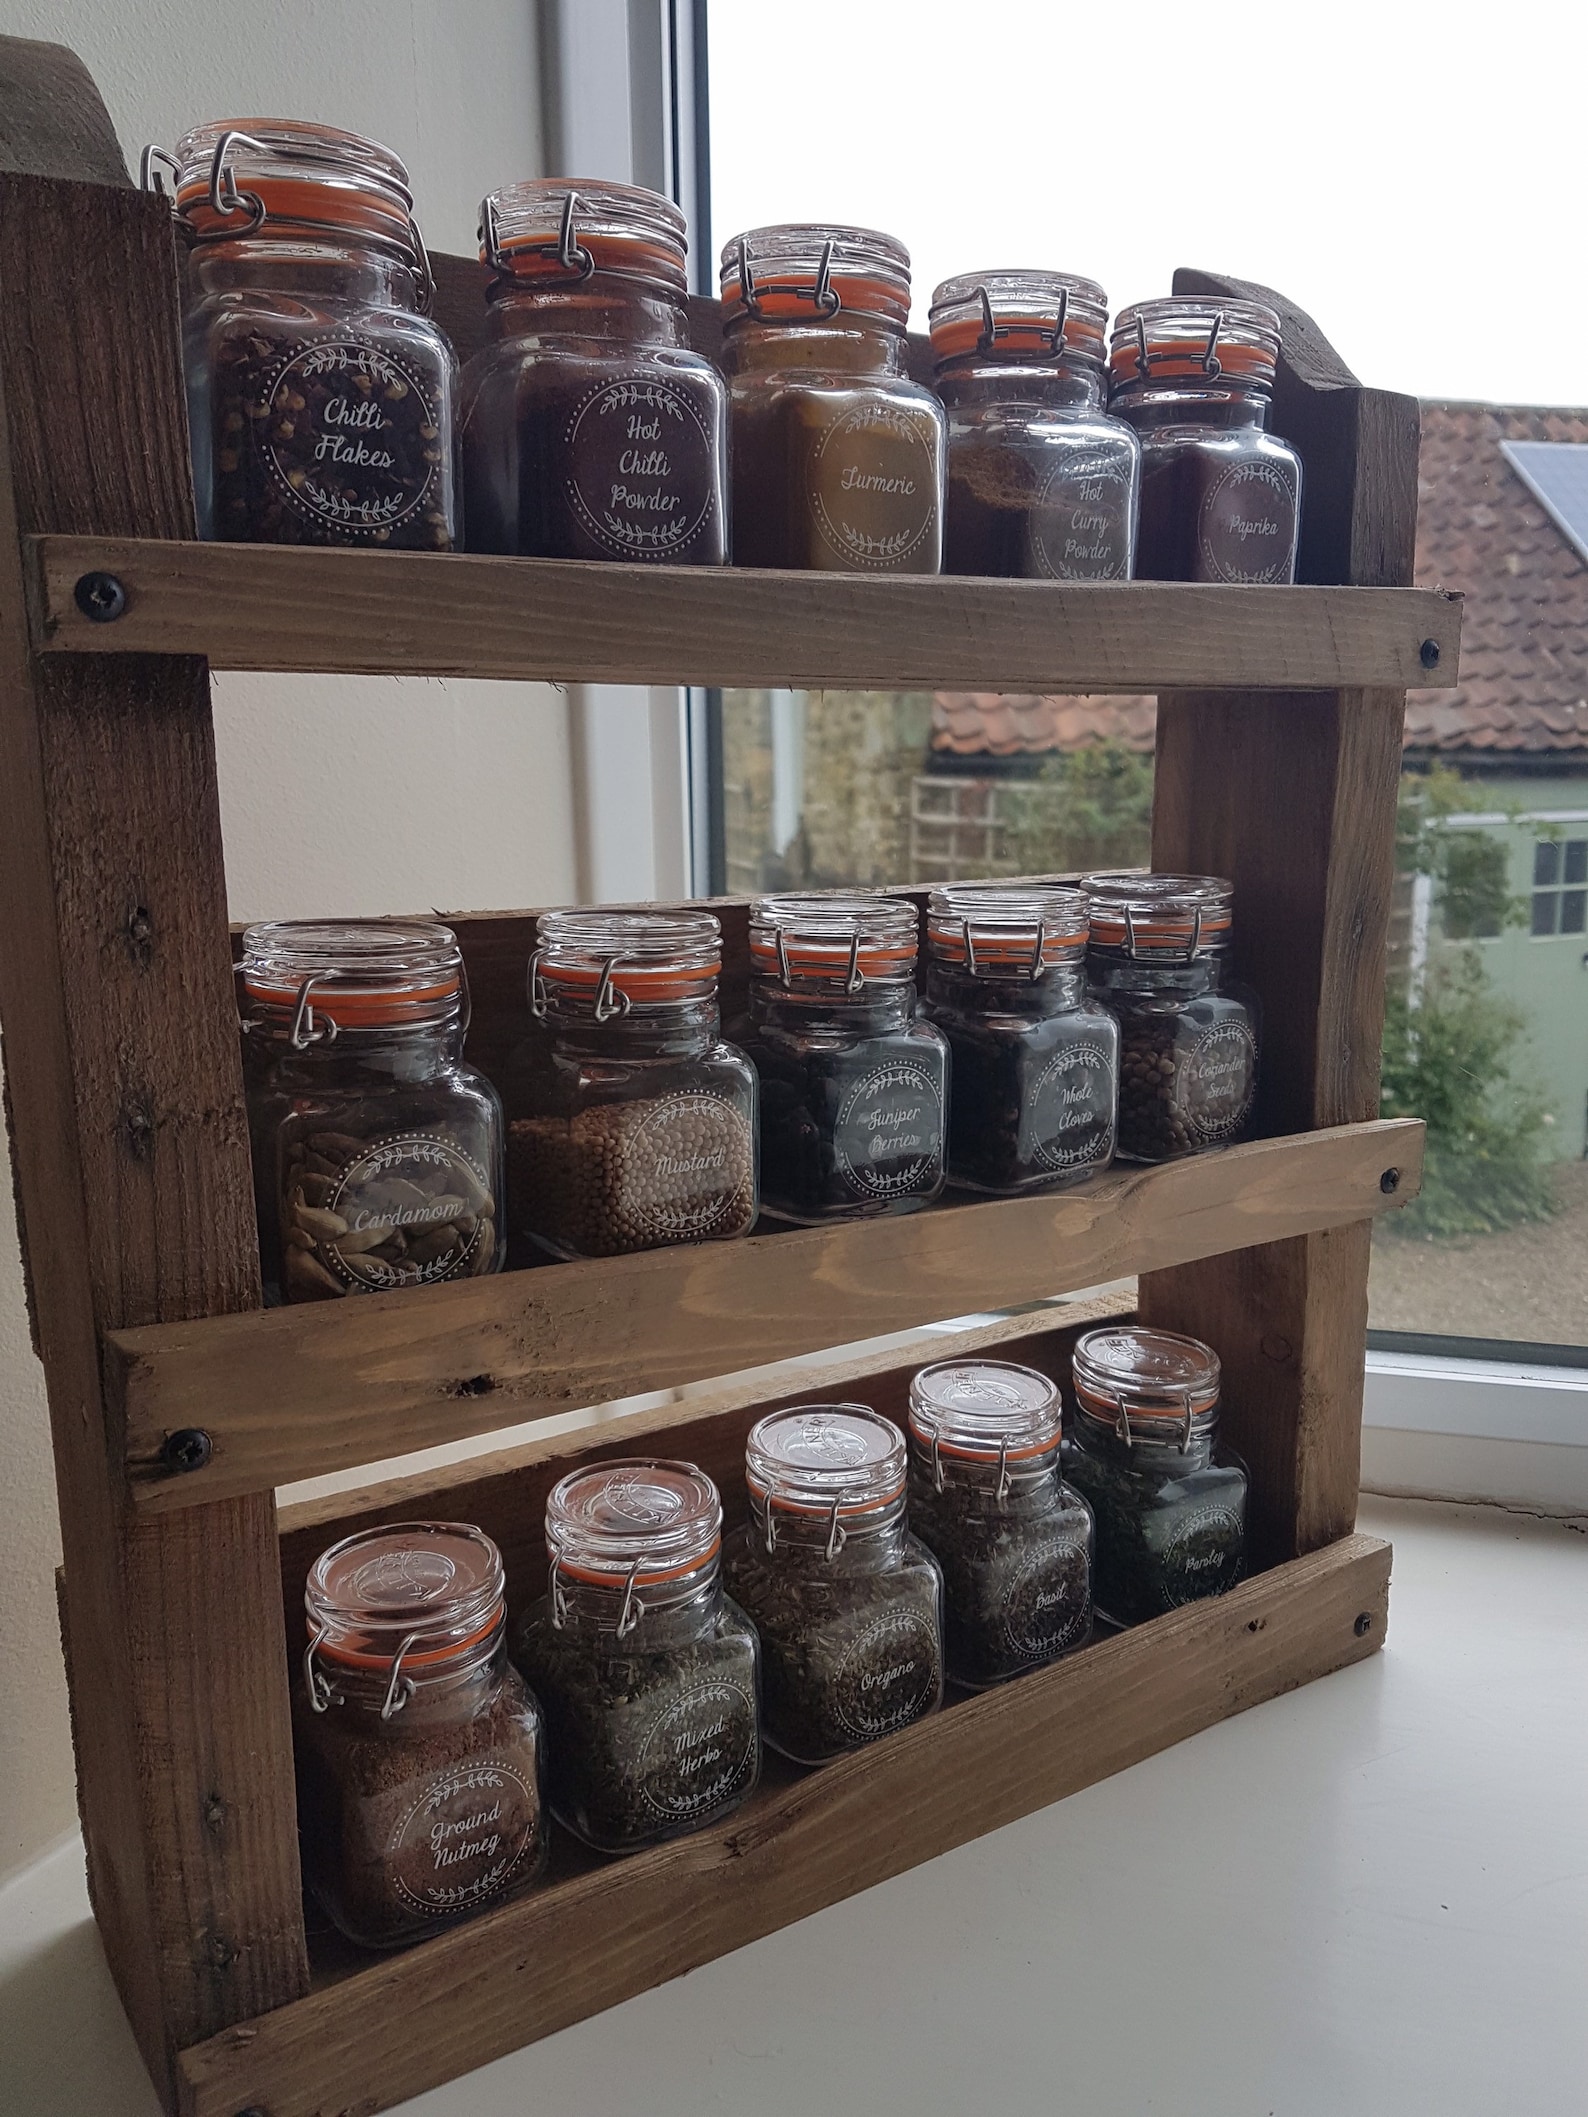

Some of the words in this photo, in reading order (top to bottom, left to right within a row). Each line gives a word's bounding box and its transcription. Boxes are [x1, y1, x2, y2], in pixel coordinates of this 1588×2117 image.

[323, 398, 386, 430] Chilli
[627, 415, 662, 440] Hot
[314, 433, 396, 468] Flakes
[619, 449, 672, 476] Chilli
[841, 466, 917, 495] Turmeric
[1079, 480, 1104, 502] Hot
[611, 485, 681, 512] Powder
[1070, 508, 1110, 539] Curry
[1228, 514, 1279, 542] Paprika
[1063, 538, 1112, 561] Powder
[1197, 1057, 1247, 1080] Coriander
[1061, 1083, 1094, 1106] Whole
[867, 1106, 922, 1132] Juniper
[1057, 1110, 1095, 1131] Cloves
[869, 1132, 917, 1155] Berries
[654, 1146, 726, 1177] Mustard
[354, 1200, 464, 1233] Cardamom
[1184, 1548, 1226, 1575] Parsley
[1035, 1581, 1068, 1611] Basil
[861, 1660, 916, 1691] Oregano
[674, 1717, 727, 1755] Mixed
[679, 1746, 724, 1777] Herbs
[430, 1800, 504, 1851] Ground
[433, 1833, 502, 1870] Nutmeg
